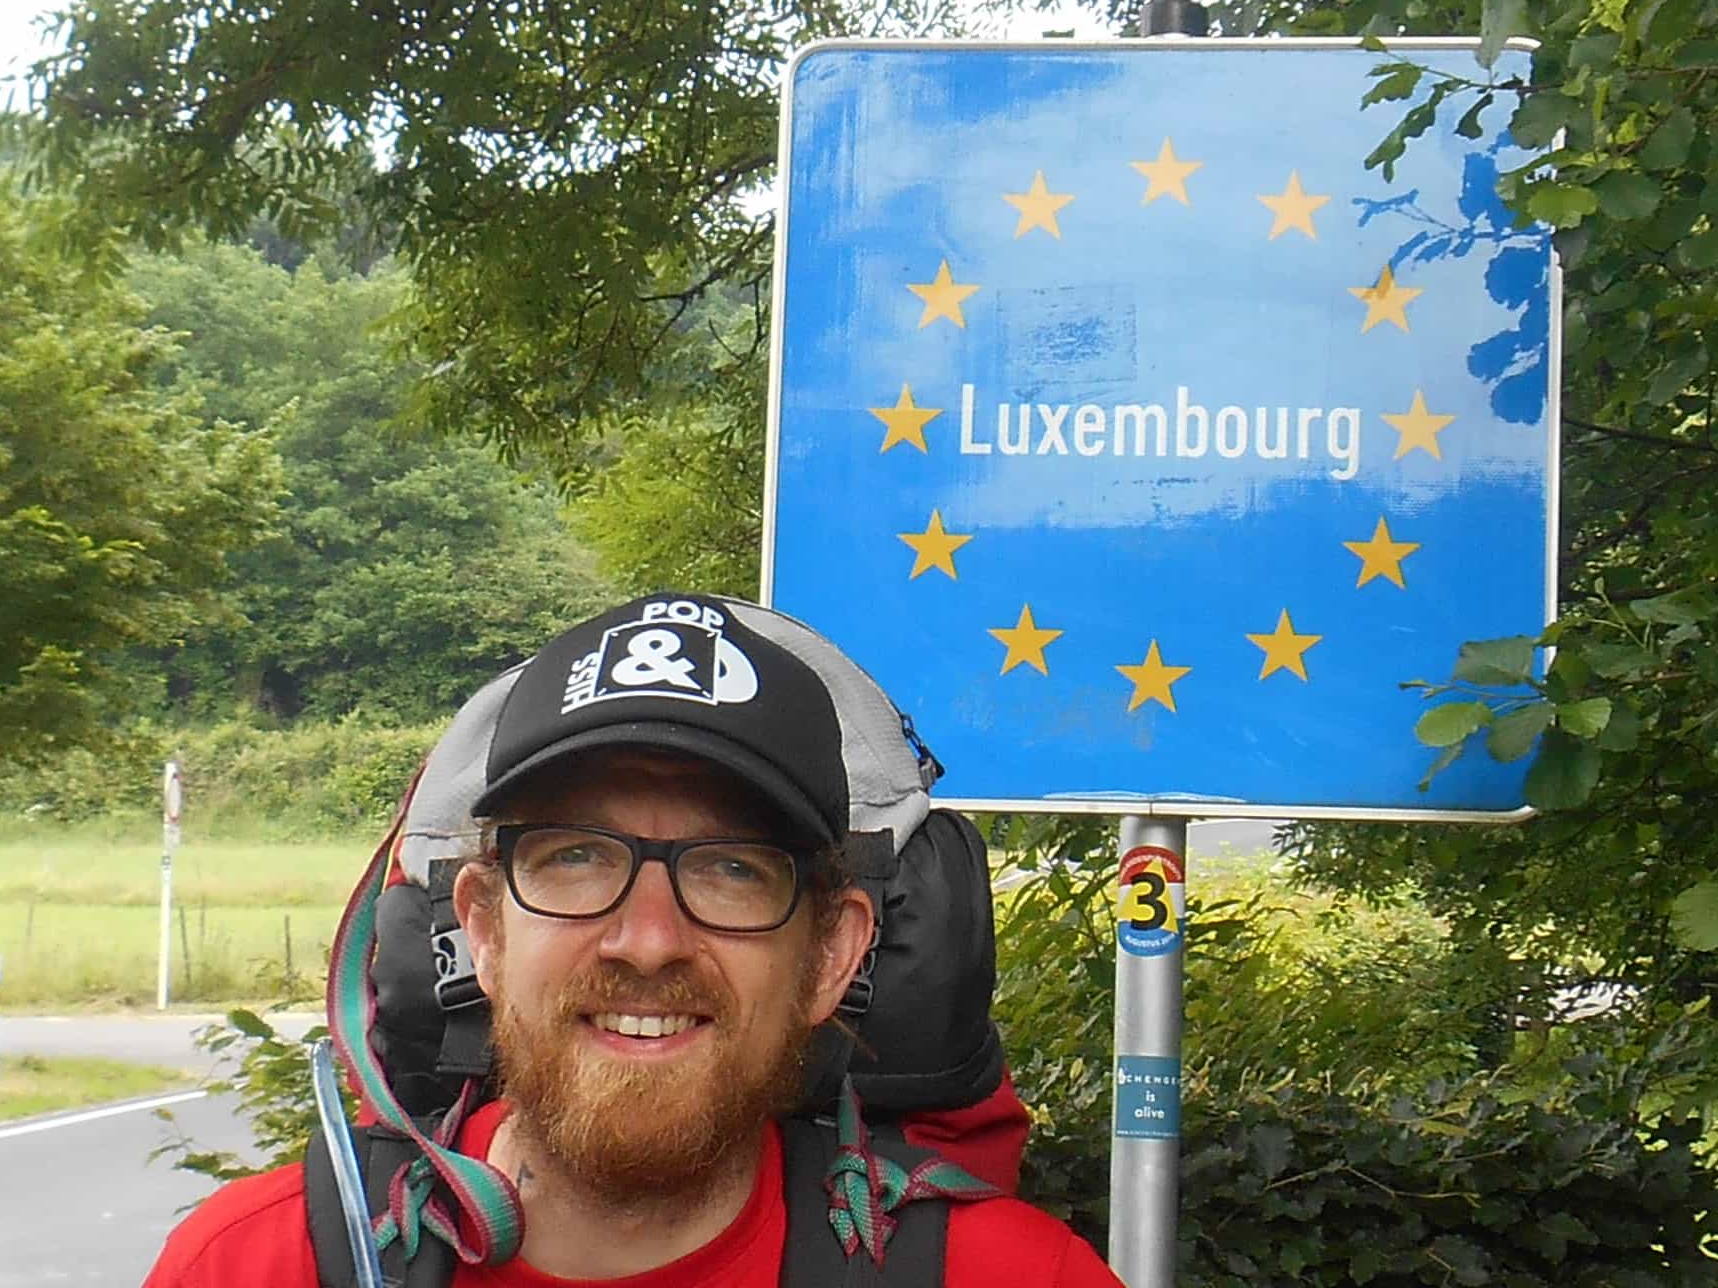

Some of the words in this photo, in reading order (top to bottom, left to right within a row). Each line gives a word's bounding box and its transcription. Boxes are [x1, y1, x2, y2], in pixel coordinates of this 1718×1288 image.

[960, 384, 1360, 480] Luxembourg
[643, 600, 724, 631] POP
[561, 652, 602, 715] HISS
[611, 629, 701, 690] &
[1131, 872, 1168, 930] 3
[1134, 1106, 1165, 1119] alive
[1146, 1090, 1155, 1102] is
